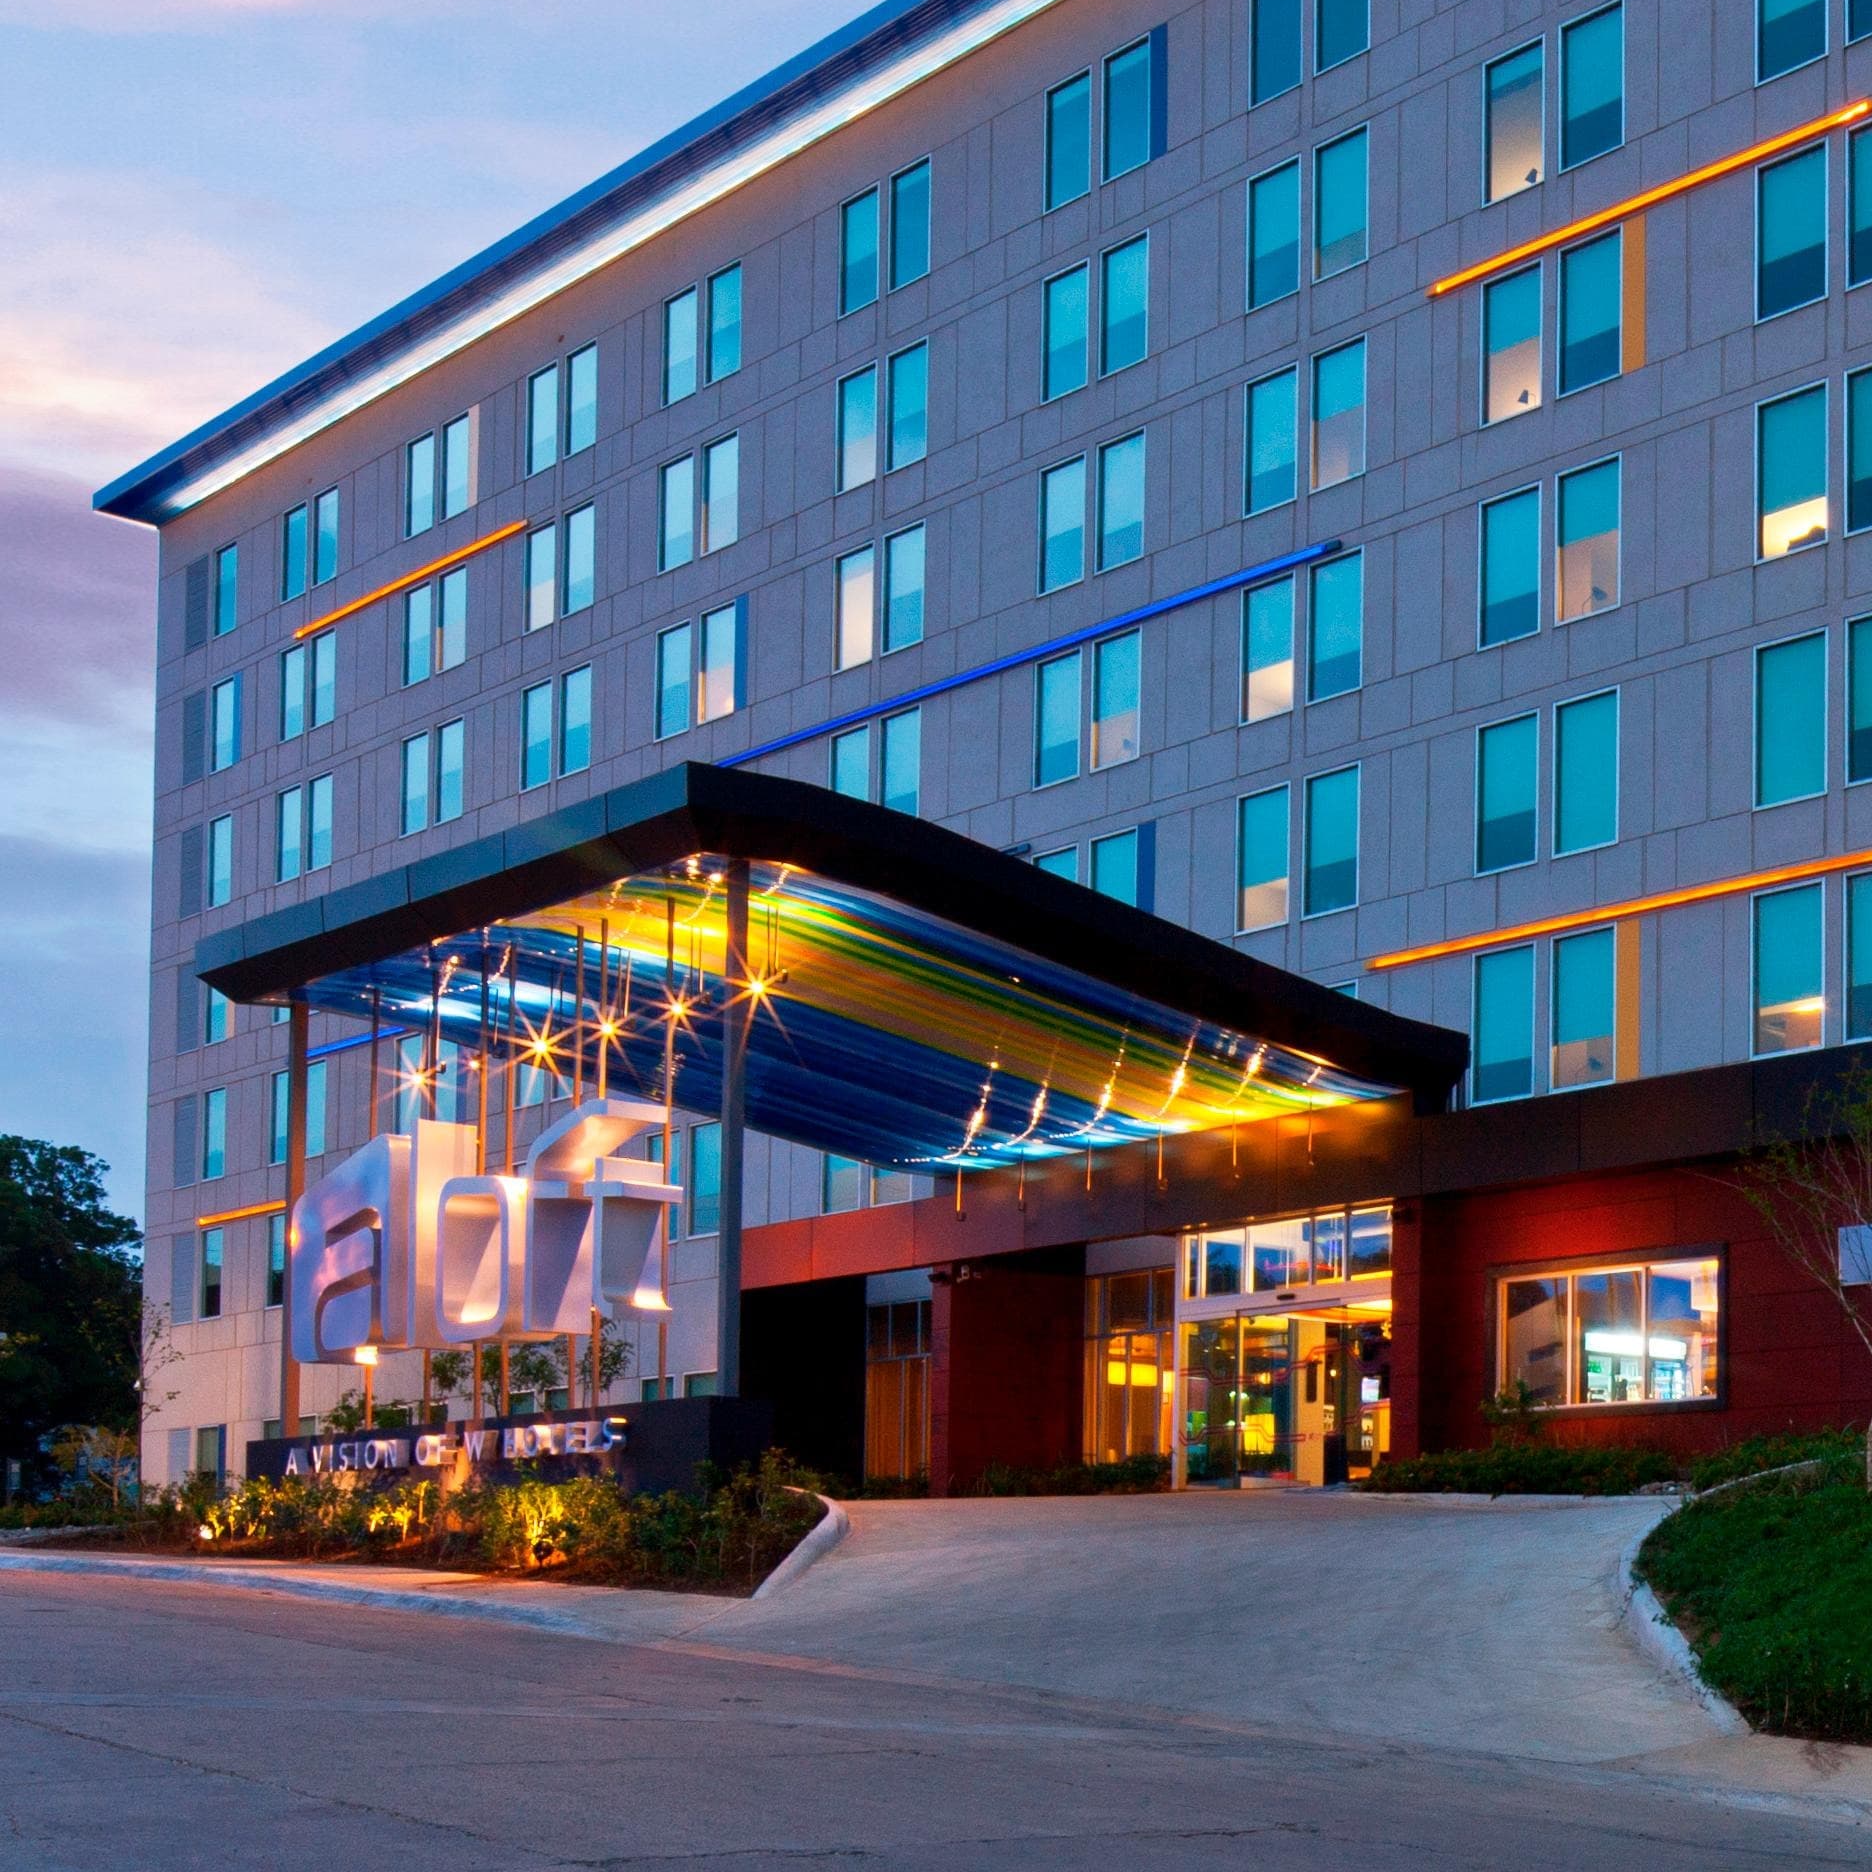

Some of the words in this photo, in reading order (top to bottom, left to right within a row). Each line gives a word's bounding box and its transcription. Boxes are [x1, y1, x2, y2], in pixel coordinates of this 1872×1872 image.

[291, 1098, 683, 1363] aloft
[285, 1449, 298, 1476] A
[312, 1439, 398, 1473] VISION
[415, 1434, 448, 1466] OF
[464, 1431, 483, 1462] W
[503, 1418, 627, 1459] HOTELS
